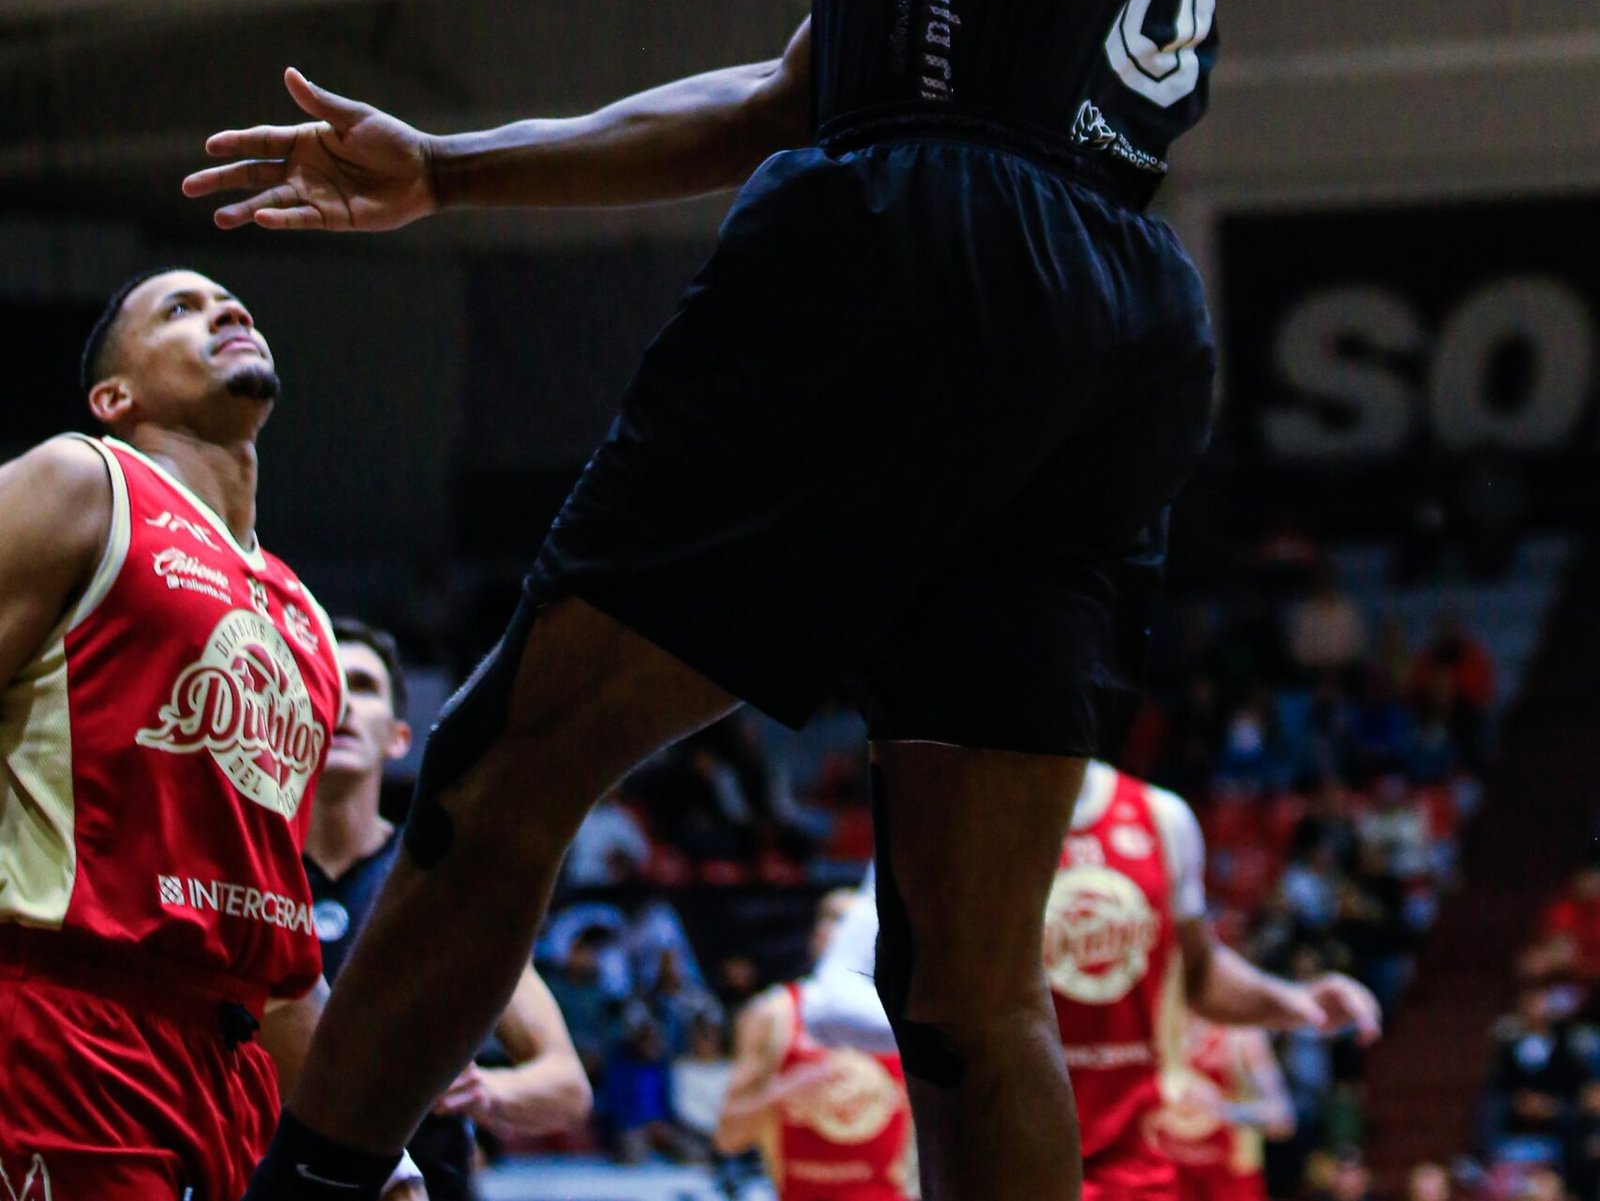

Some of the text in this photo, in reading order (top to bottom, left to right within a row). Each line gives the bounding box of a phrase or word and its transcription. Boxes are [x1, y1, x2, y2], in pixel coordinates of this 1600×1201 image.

[215, 623, 266, 660] DIABLOS
[136, 666, 325, 776] Diablos
[229, 756, 263, 796] DEL
